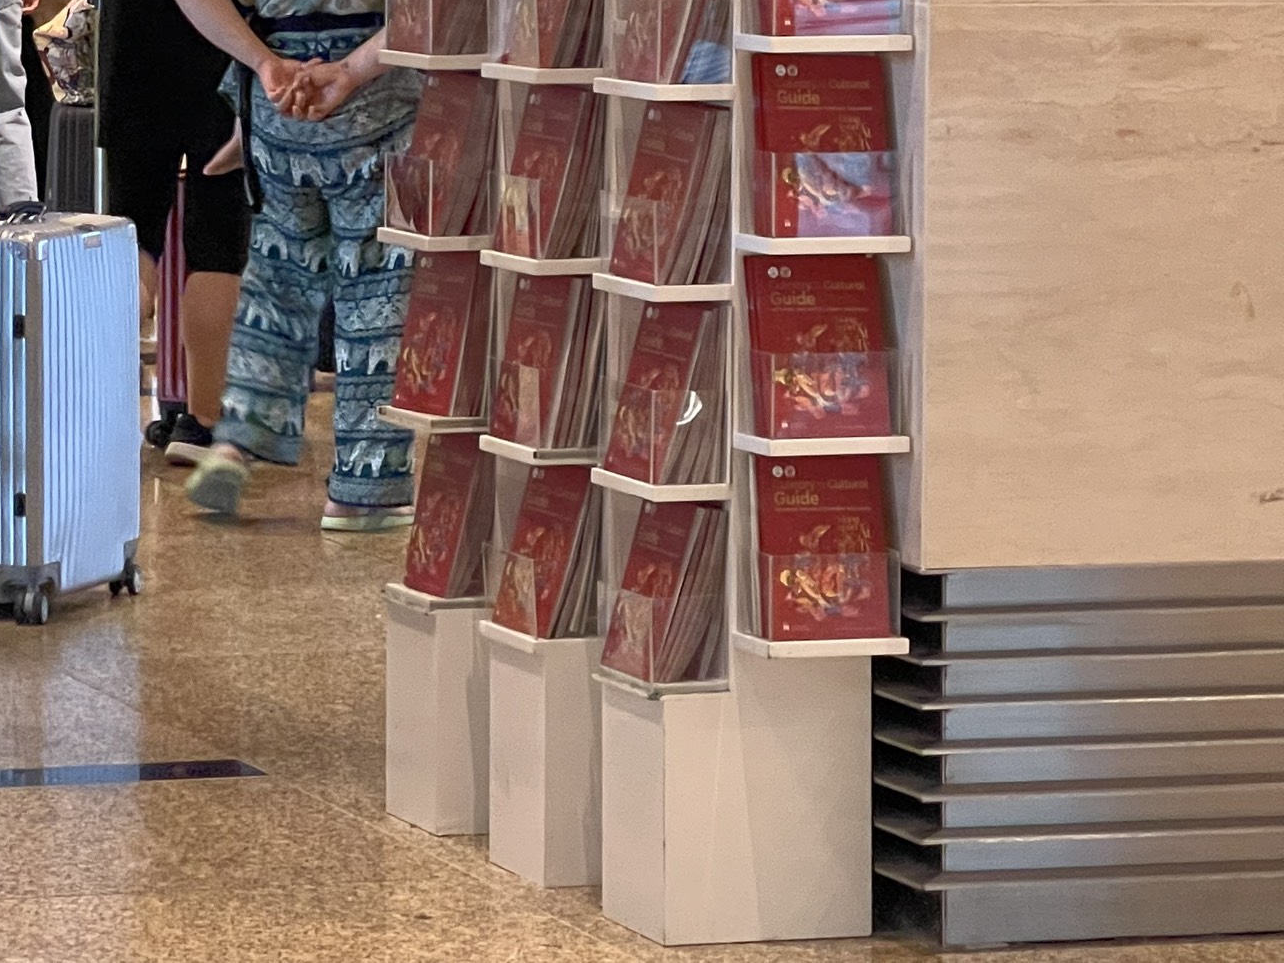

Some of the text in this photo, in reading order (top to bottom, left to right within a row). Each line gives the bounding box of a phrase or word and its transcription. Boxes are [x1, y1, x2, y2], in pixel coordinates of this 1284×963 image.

[777, 89, 820, 105] Guide
[771, 290, 816, 306] Guide
[774, 489, 819, 506] Guide
